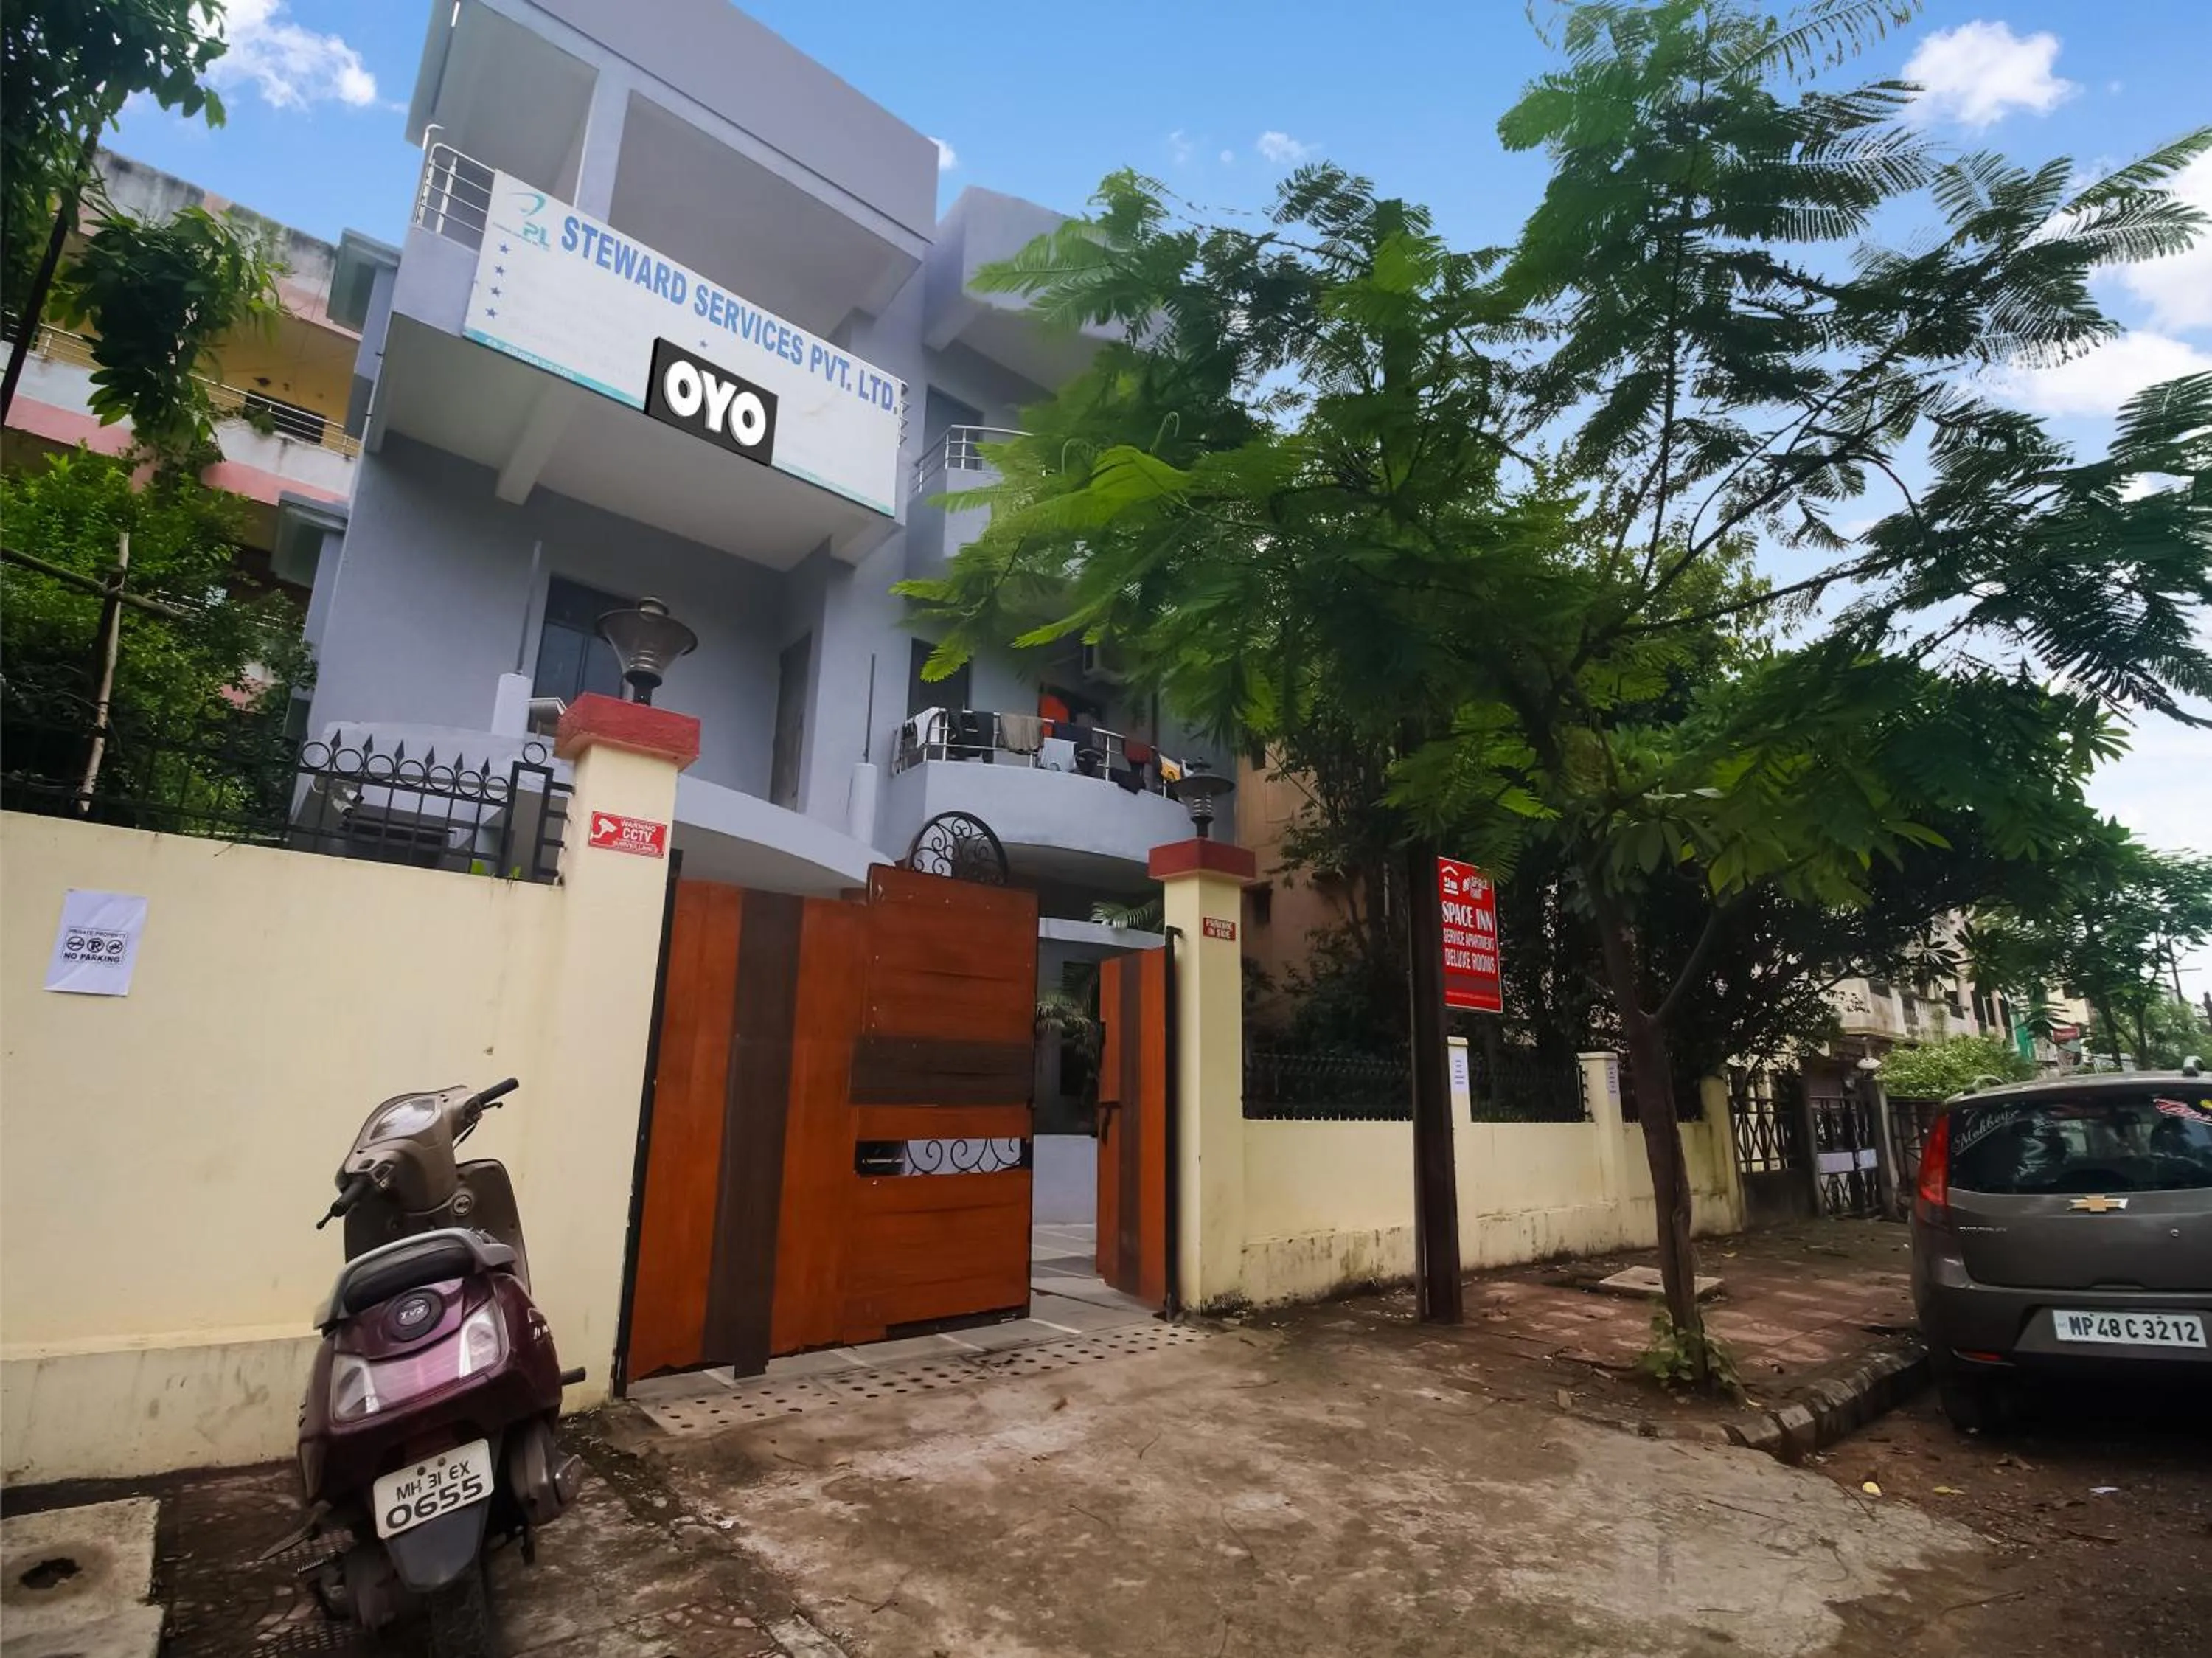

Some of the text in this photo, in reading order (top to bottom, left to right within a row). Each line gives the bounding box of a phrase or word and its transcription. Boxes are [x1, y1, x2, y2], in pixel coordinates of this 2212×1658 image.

[561, 215, 898, 415] STEWARD SERVICES PVT. LTD.
[664, 360, 767, 447] OYO
[622, 827, 653, 843] CCTV
[1442, 901, 1493, 933] SPACE INN
[80, 953, 120, 962] PARKING
[2142, 1319, 2199, 1342] 3212
[396, 1480, 422, 1502] MH
[449, 1460, 470, 1480] EX
[386, 1474, 484, 1529] 0655
